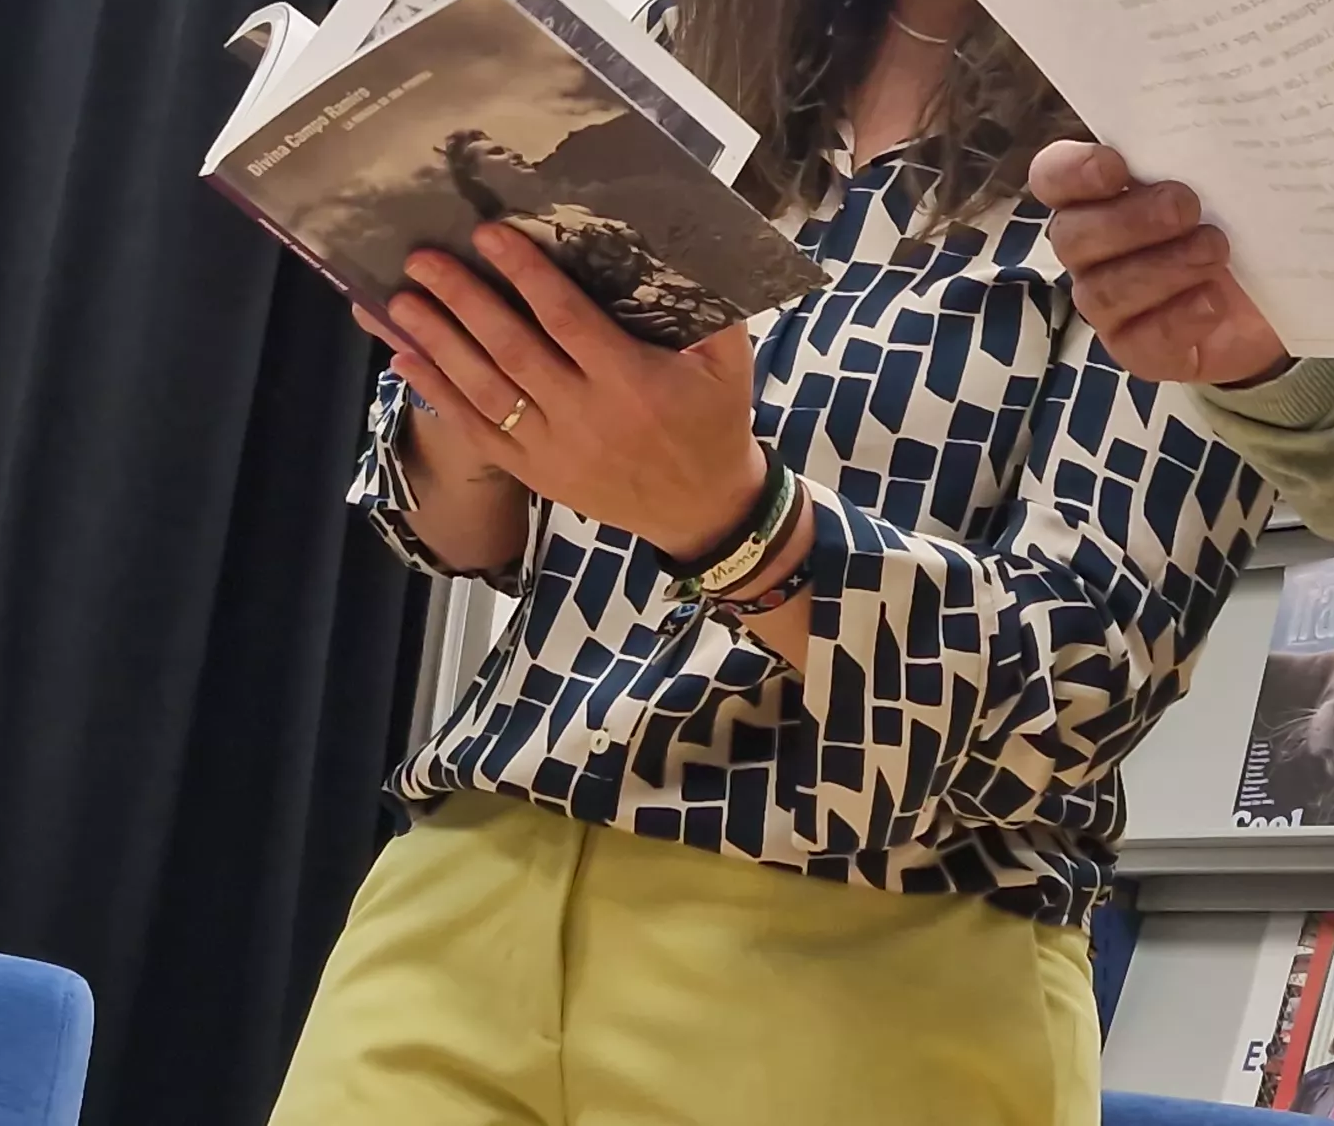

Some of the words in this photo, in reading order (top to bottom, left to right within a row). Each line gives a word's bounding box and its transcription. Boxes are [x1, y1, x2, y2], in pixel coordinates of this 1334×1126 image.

[246, 143, 292, 177] Divina
[283, 115, 330, 149] Campo
[323, 86, 371, 120] Ramiro
